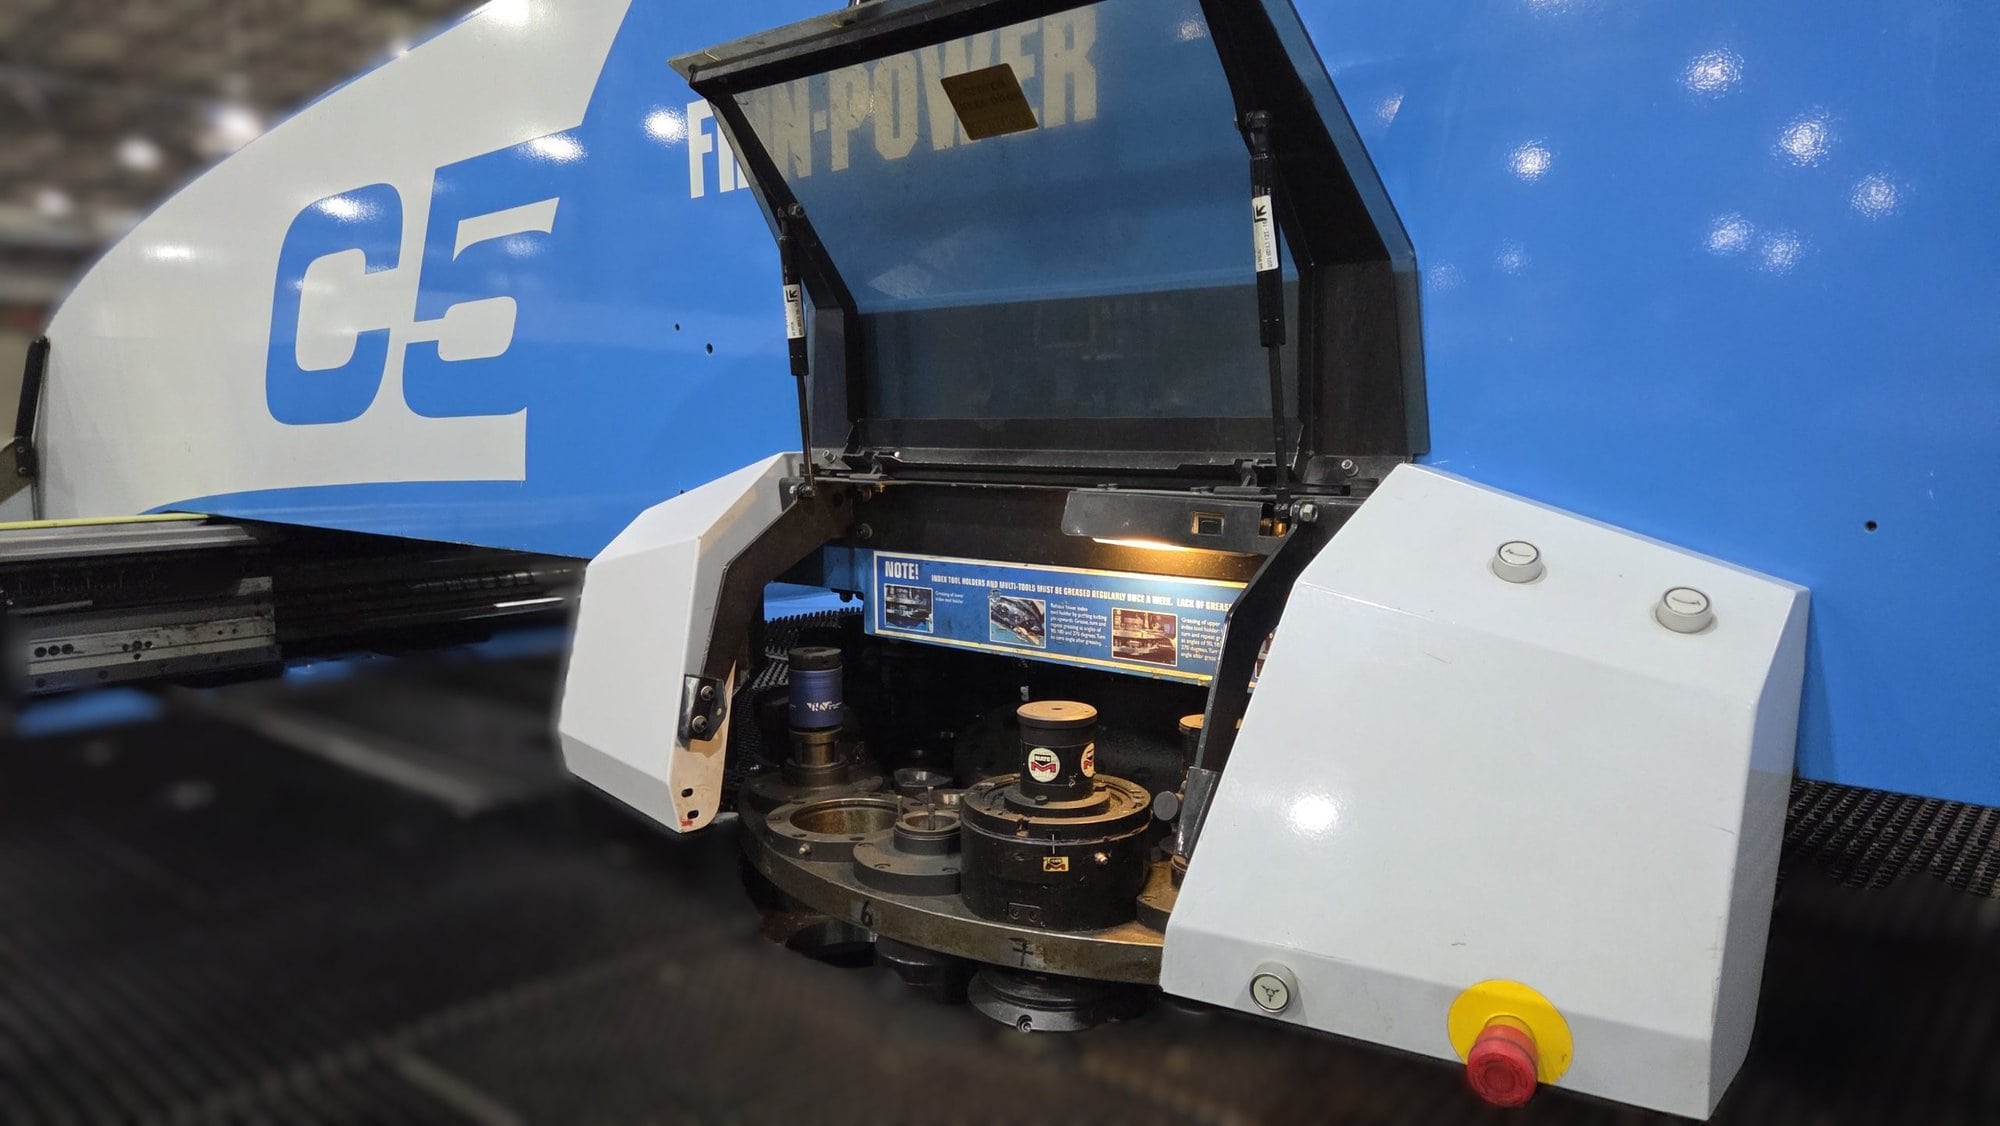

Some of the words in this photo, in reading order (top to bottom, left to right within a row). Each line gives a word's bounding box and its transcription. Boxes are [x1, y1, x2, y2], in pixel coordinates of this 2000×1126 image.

[885, 561, 919, 580] NOTE!
[932, 575, 947, 583] INDEX
[948, 576, 961, 584] TOOL
[962, 577, 985, 587] HOLDERS
[986, 579, 999, 588] AND
[999, 580, 1036, 592] MULTI-TOOLS
[1036, 583, 1053, 594] MUST
[1054, 586, 1063, 595] BE
[1063, 587, 1091, 598] GREASED
[1091, 589, 1126, 601] REGULARLY
[1126, 593, 1145, 603] ONCE
[1145, 594, 1151, 604] A
[1176, 598, 1195, 608] LACK
[1196, 599, 1205, 609] OF
[861, 900, 873, 927] 6
[1008, 937, 1034, 967] 7
